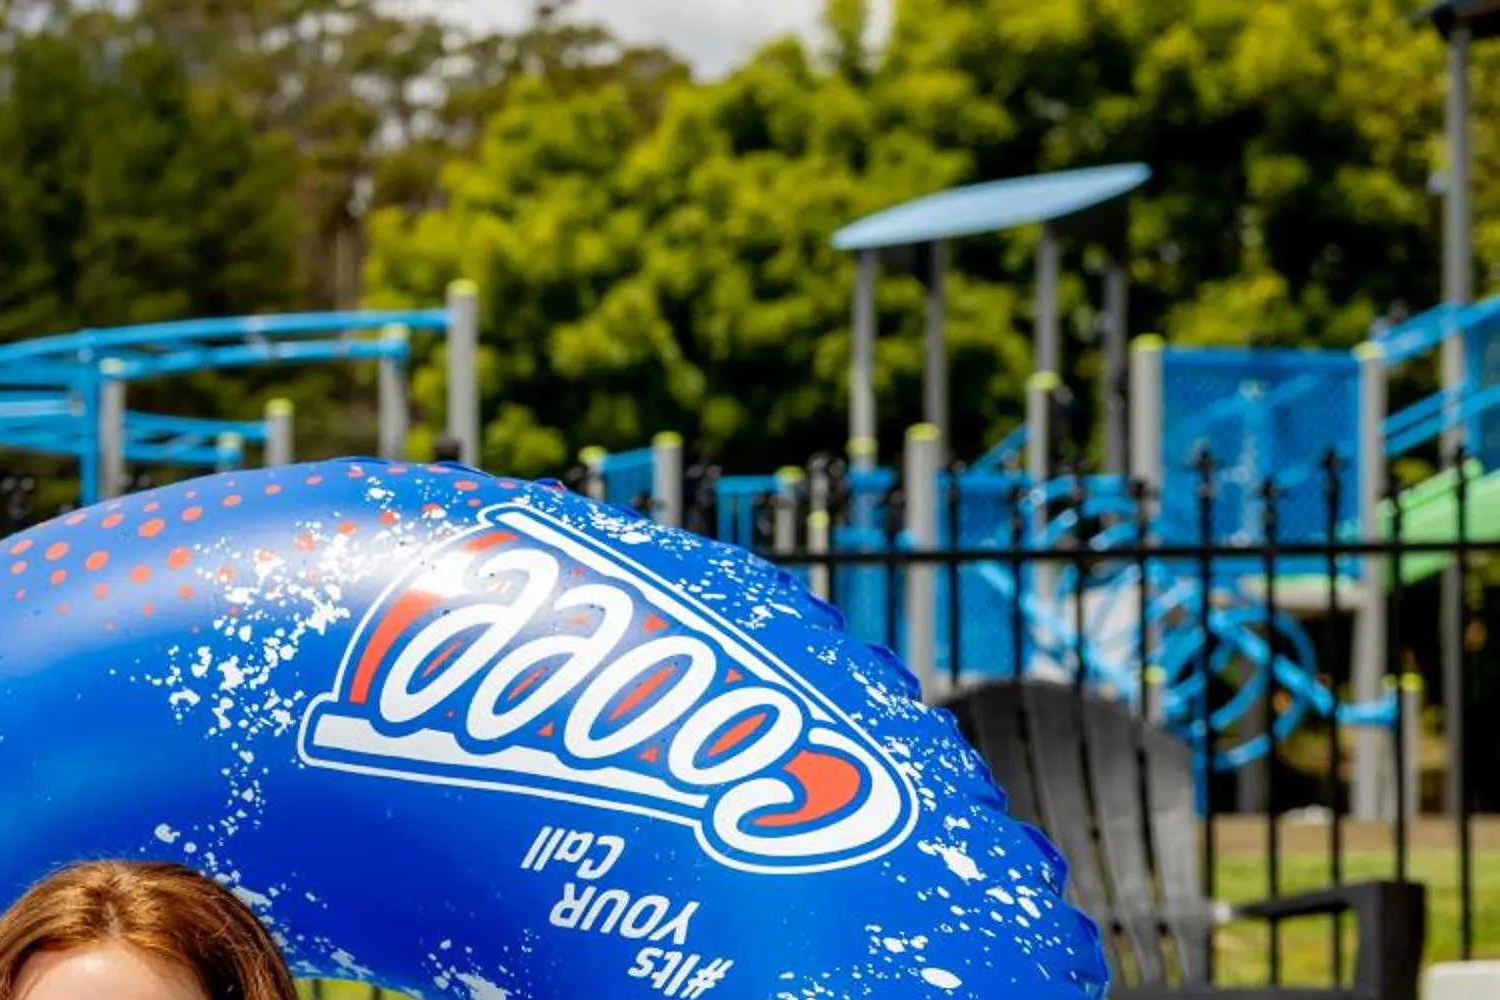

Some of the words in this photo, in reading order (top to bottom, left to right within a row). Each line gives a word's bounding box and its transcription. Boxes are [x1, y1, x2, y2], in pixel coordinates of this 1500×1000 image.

[520, 825, 625, 880] Call
[549, 882, 700, 945] YOUR
[627, 947, 734, 1000] #Its
